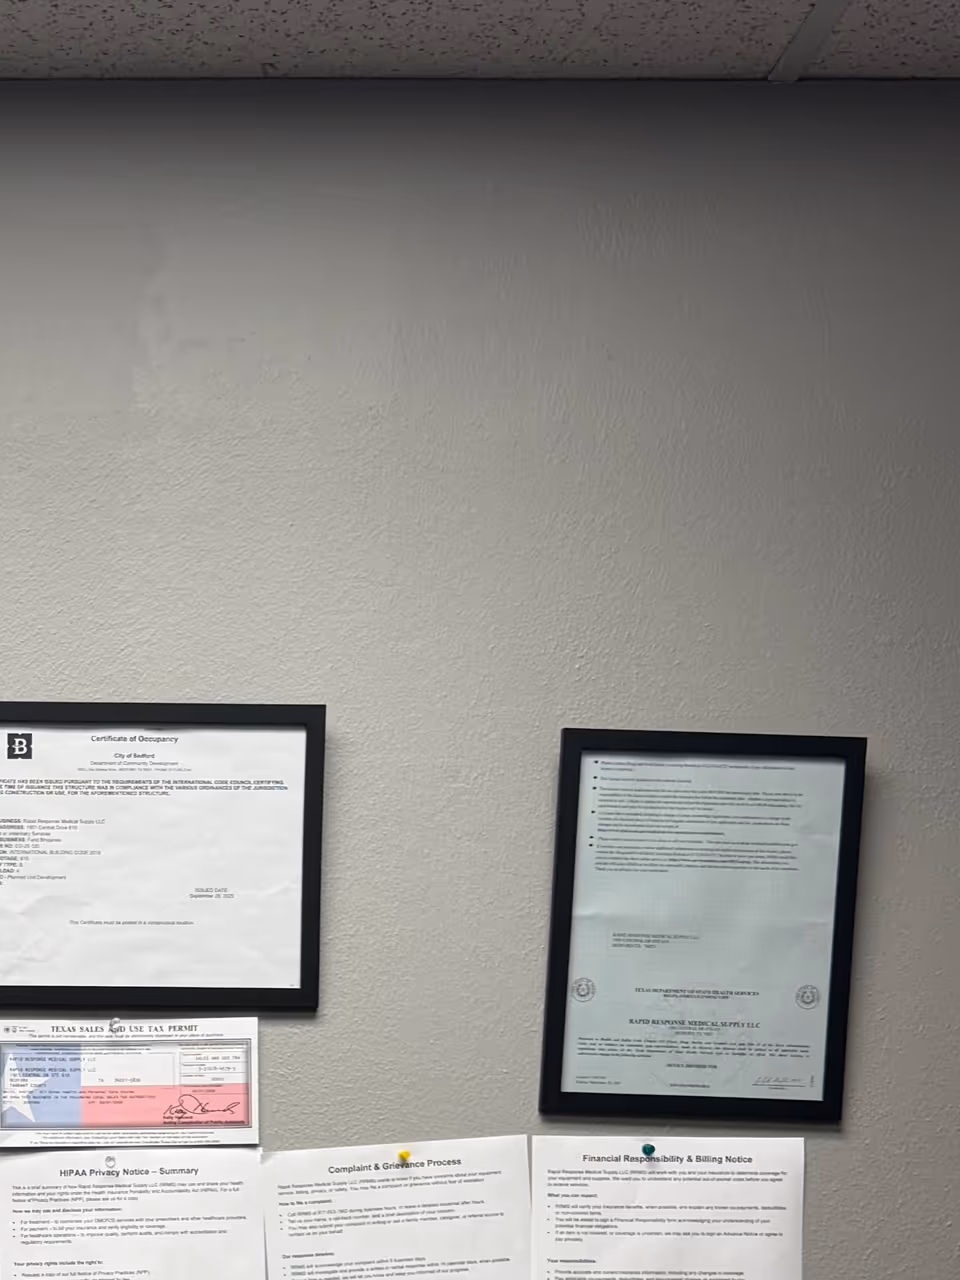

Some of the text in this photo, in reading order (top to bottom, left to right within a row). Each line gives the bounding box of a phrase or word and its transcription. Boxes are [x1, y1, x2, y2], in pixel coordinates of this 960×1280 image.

[137, 735, 178, 743] Occupancy
[51, 1025, 76, 1033] TEXAS
[168, 1024, 197, 1032] PERMIT
[582, 1154, 621, 1162] Financial
[623, 1155, 684, 1165] Responsibility
[695, 1155, 722, 1164] Billing
[725, 1155, 752, 1163] Notice
[328, 1157, 461, 1174] Complaint & Grievance Process
[59, 1168, 87, 1177] HIPAA
[89, 1168, 120, 1177] Privacy
[159, 1167, 198, 1176] Summary
